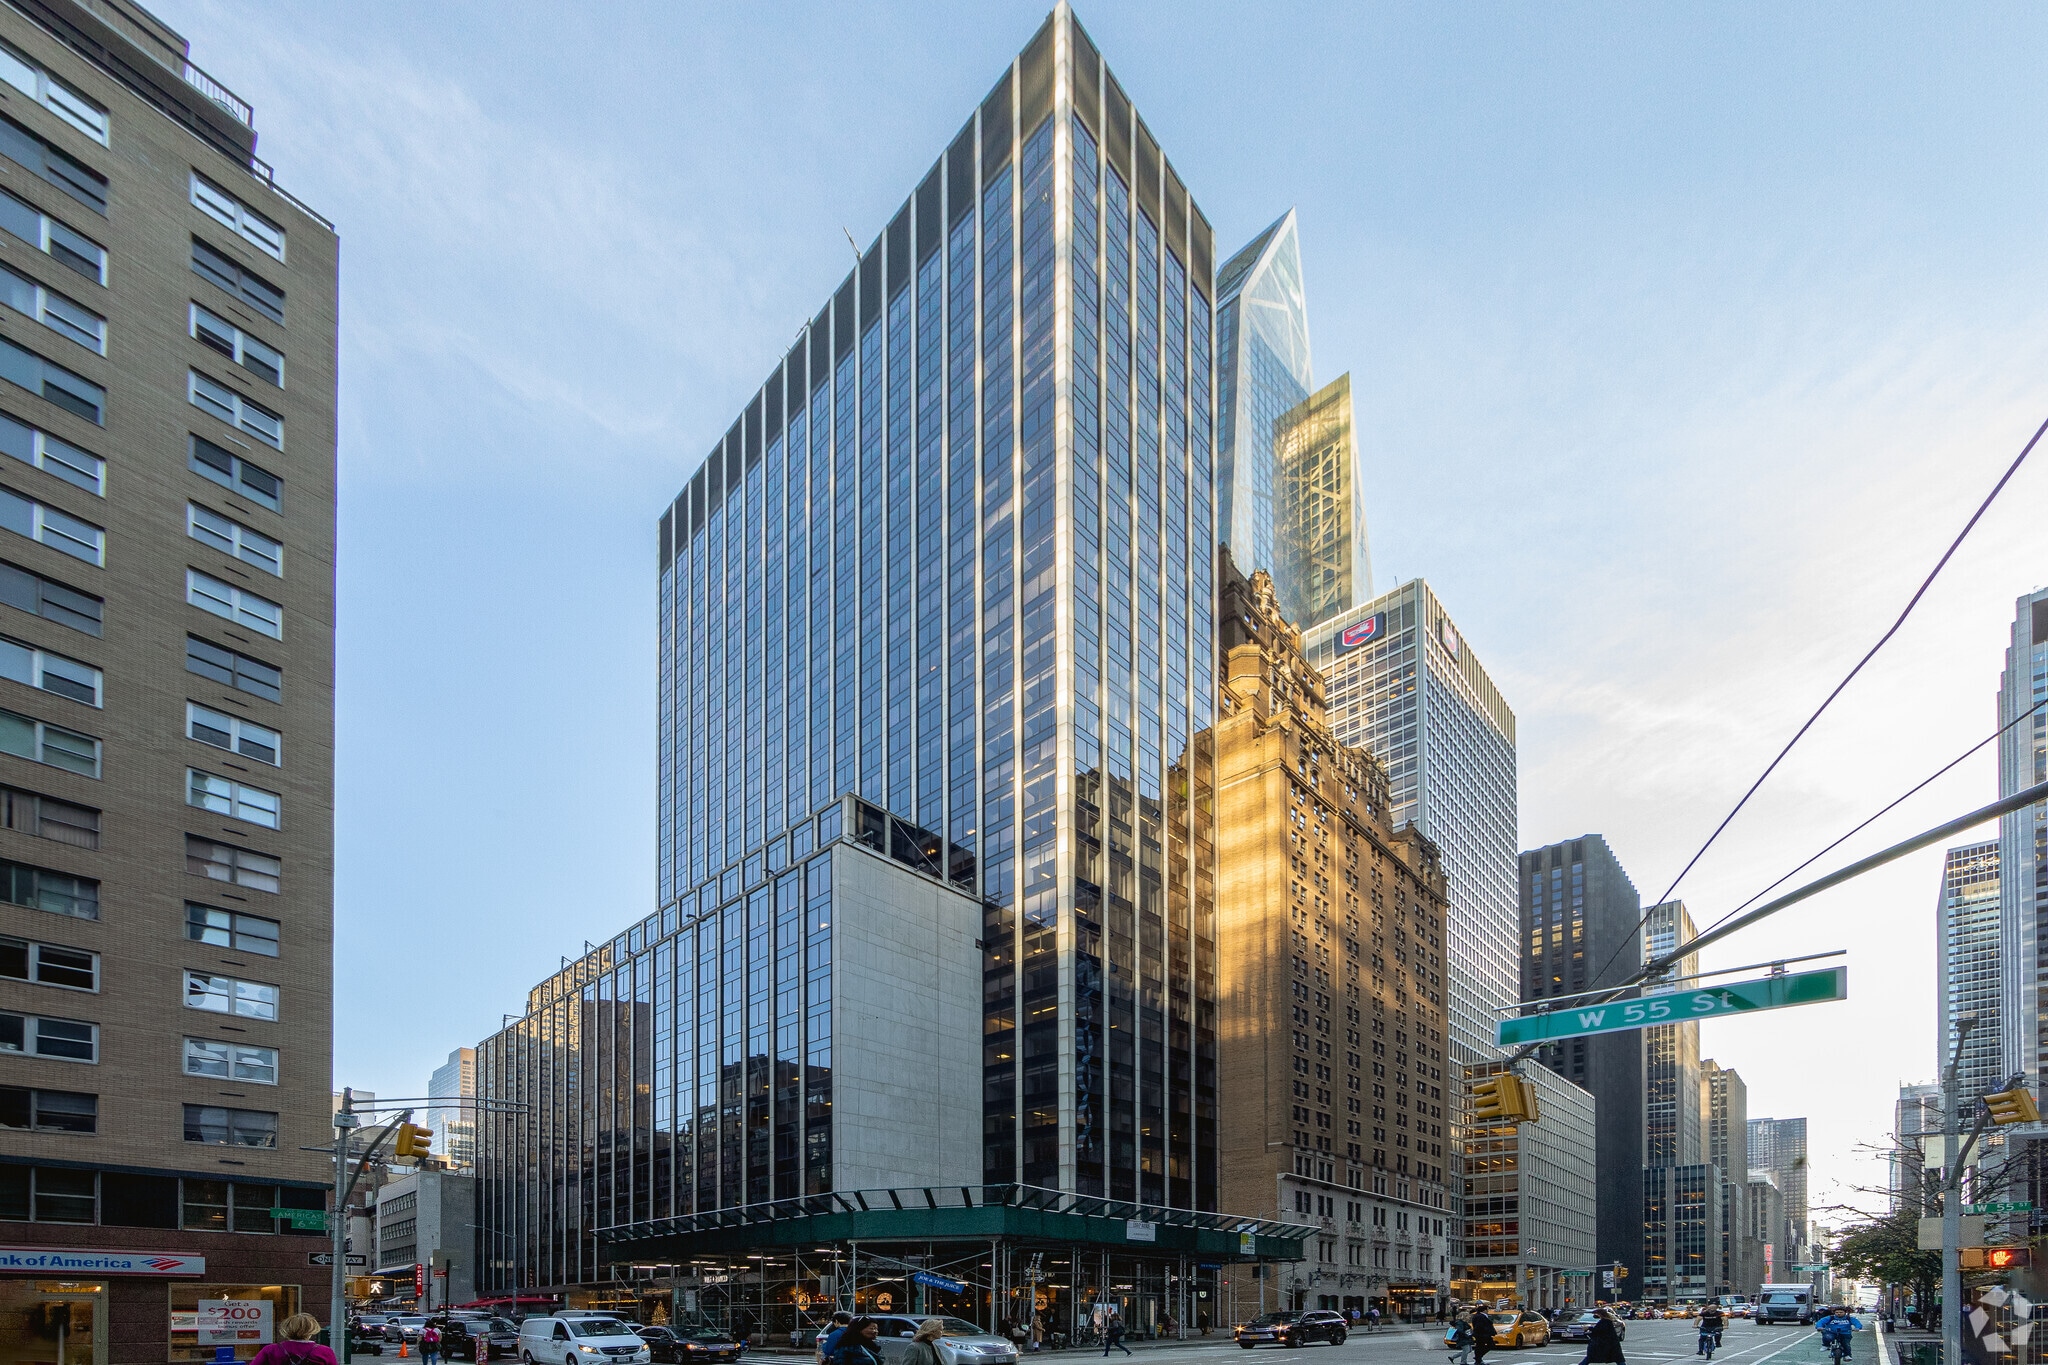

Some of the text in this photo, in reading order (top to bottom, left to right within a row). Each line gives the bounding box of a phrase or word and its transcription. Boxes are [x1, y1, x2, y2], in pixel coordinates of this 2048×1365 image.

[1578, 991, 1734, 1029] W 55 St
[1977, 1204, 1987, 1212] W
[1997, 1203, 2015, 1211] 55
[297, 1220, 306, 1228] 6
[25, 1255, 47, 1266] of
[49, 1256, 132, 1269] America
[208, 1307, 262, 1320] $200
